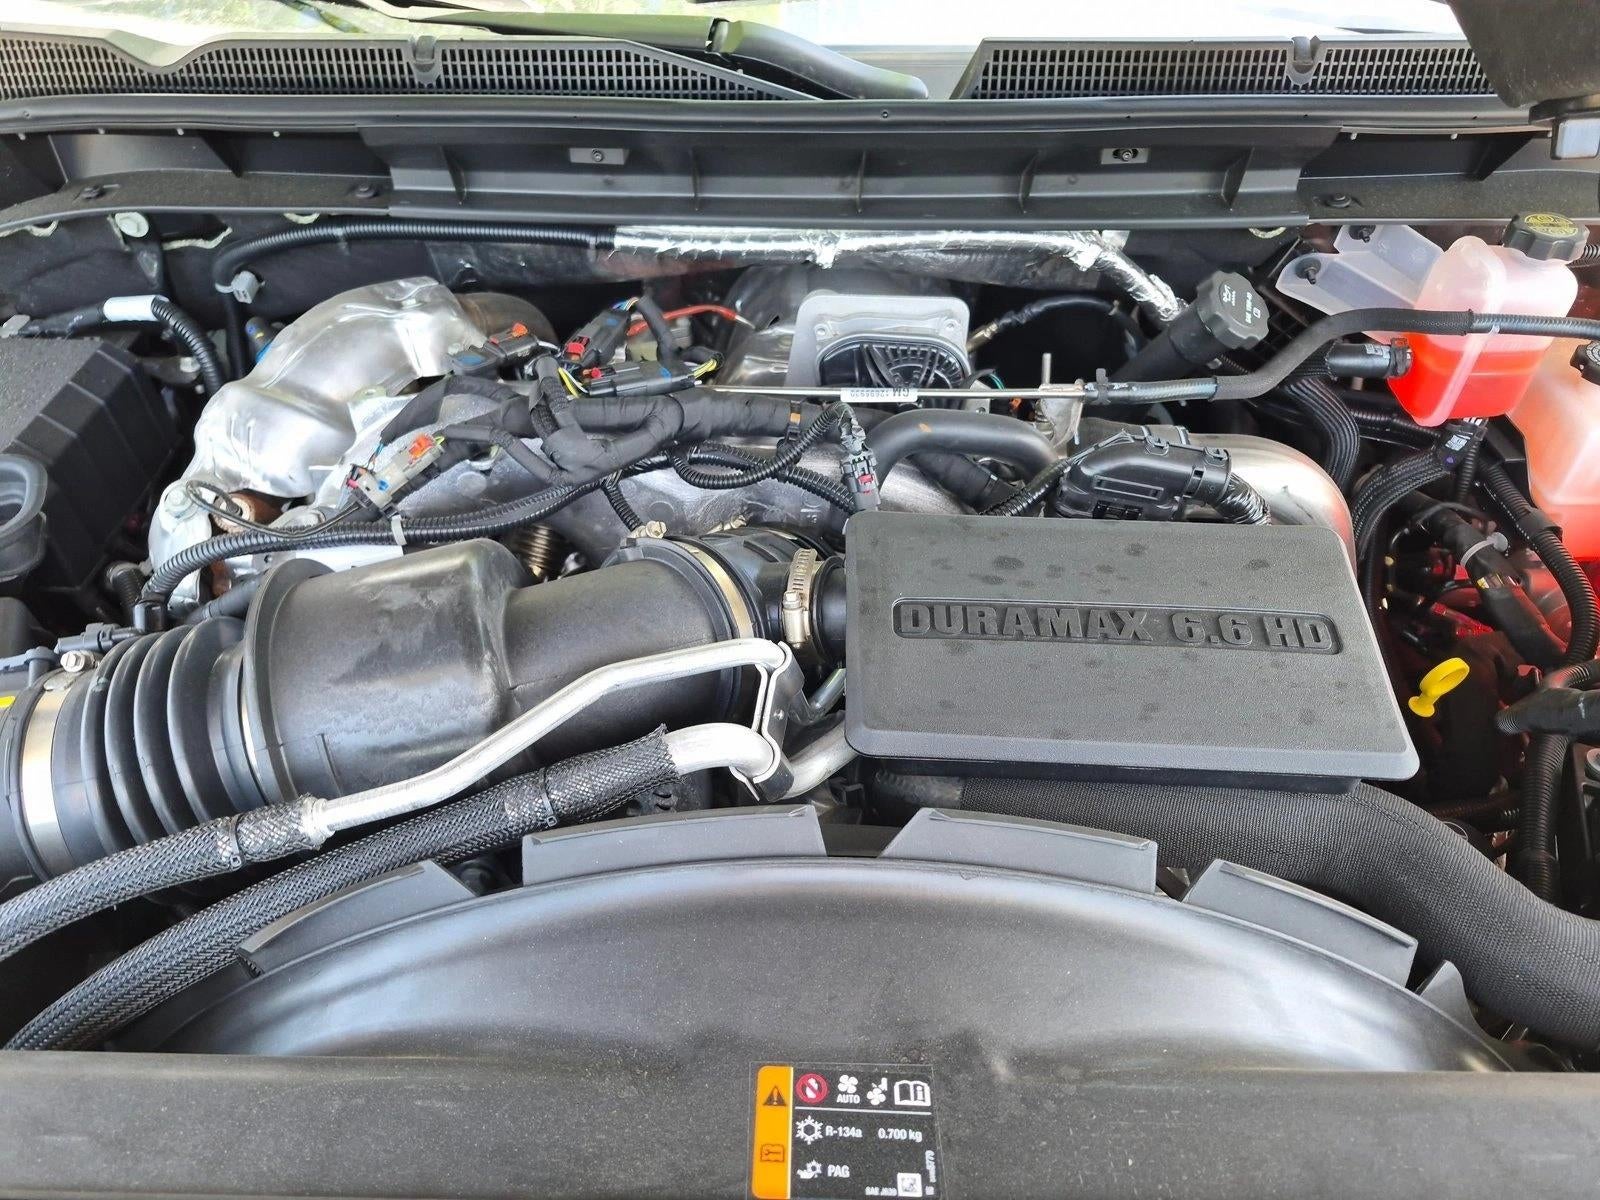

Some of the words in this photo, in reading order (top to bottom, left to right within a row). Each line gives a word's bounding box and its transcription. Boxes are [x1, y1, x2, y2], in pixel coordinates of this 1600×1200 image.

[902, 605, 1154, 641] DURAMAX
[1171, 612, 1254, 646] 6.6
[1263, 615, 1333, 650] HD
[836, 1093, 860, 1104] AUTO
[825, 1125, 863, 1138] R-134a
[878, 1127, 907, 1140] 0.700
[908, 1129, 923, 1143] kg
[827, 1164, 850, 1178] PAG
